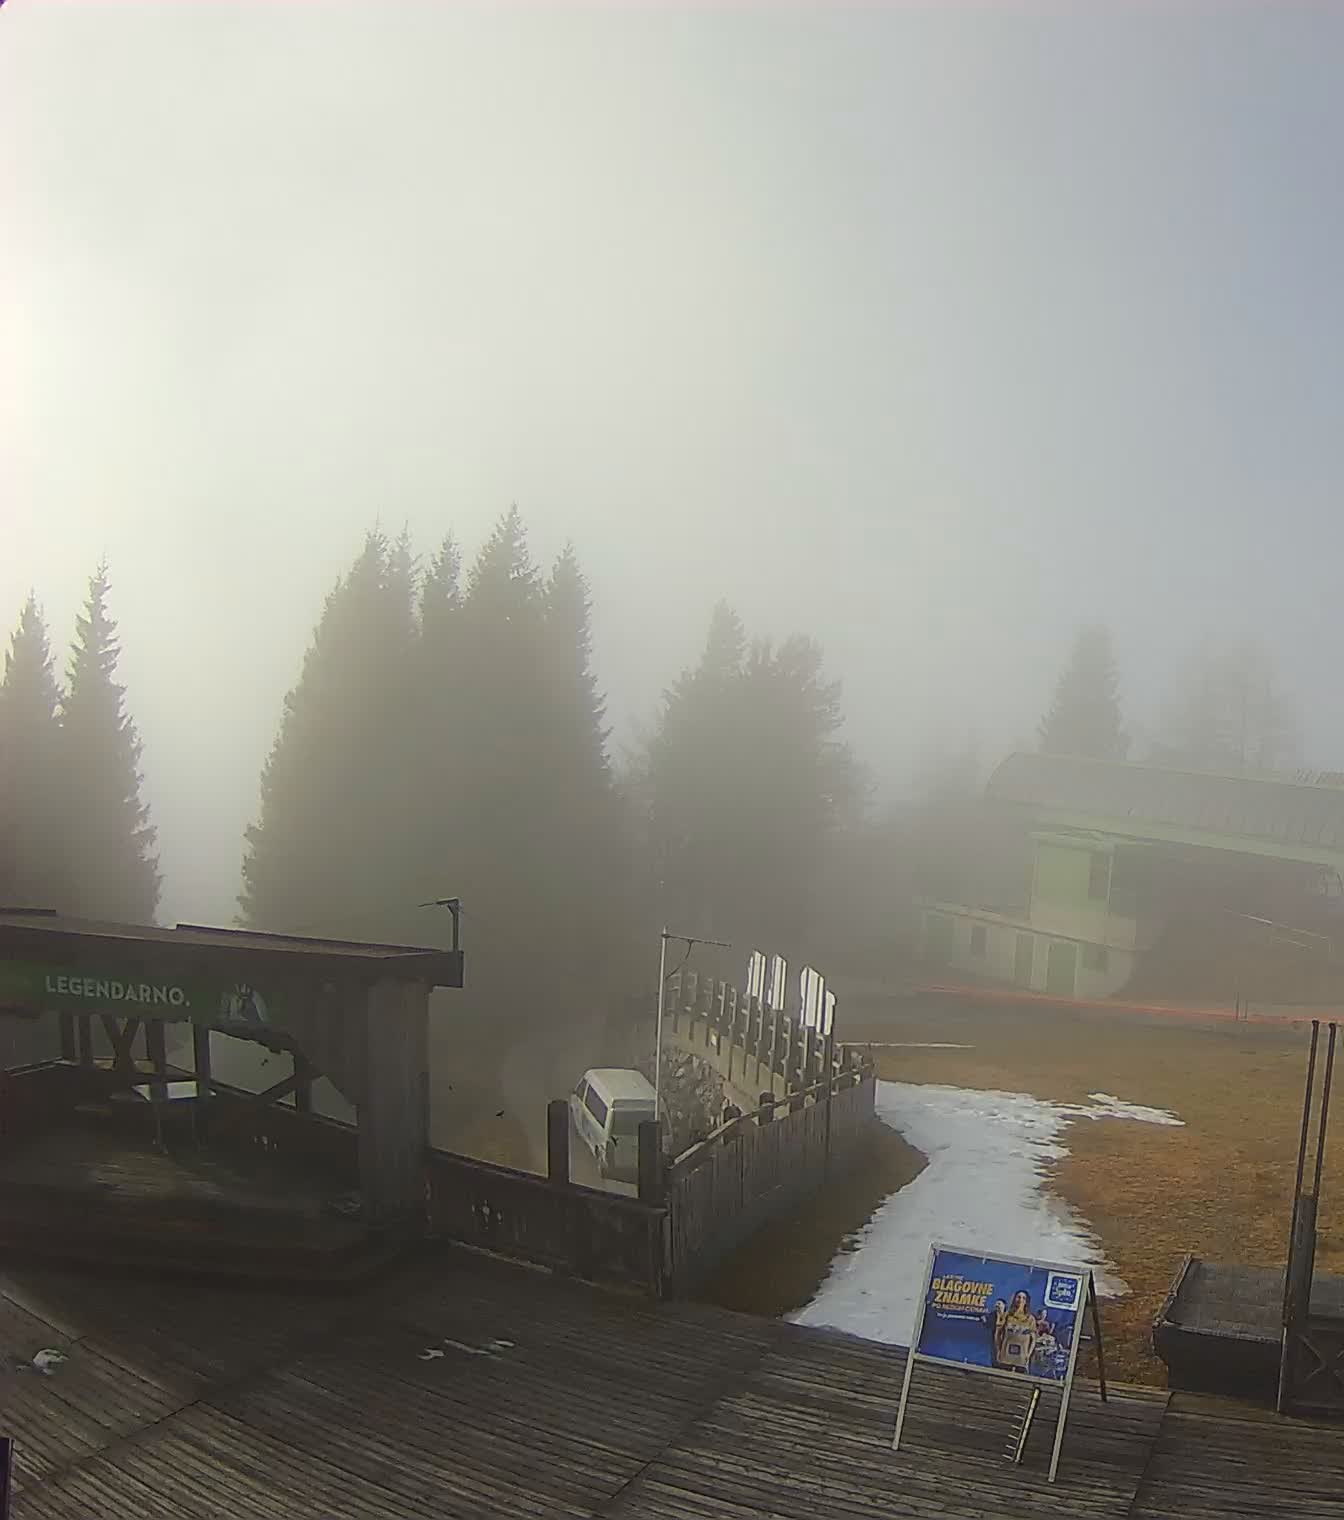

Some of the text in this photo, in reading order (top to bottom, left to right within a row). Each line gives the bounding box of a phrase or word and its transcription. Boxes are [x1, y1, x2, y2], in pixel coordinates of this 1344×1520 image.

[45, 976, 191, 1007] LEGENDARNO.
[932, 1278, 993, 1295] BLAGOVNE
[935, 1291, 987, 1306] ZNAMKE
